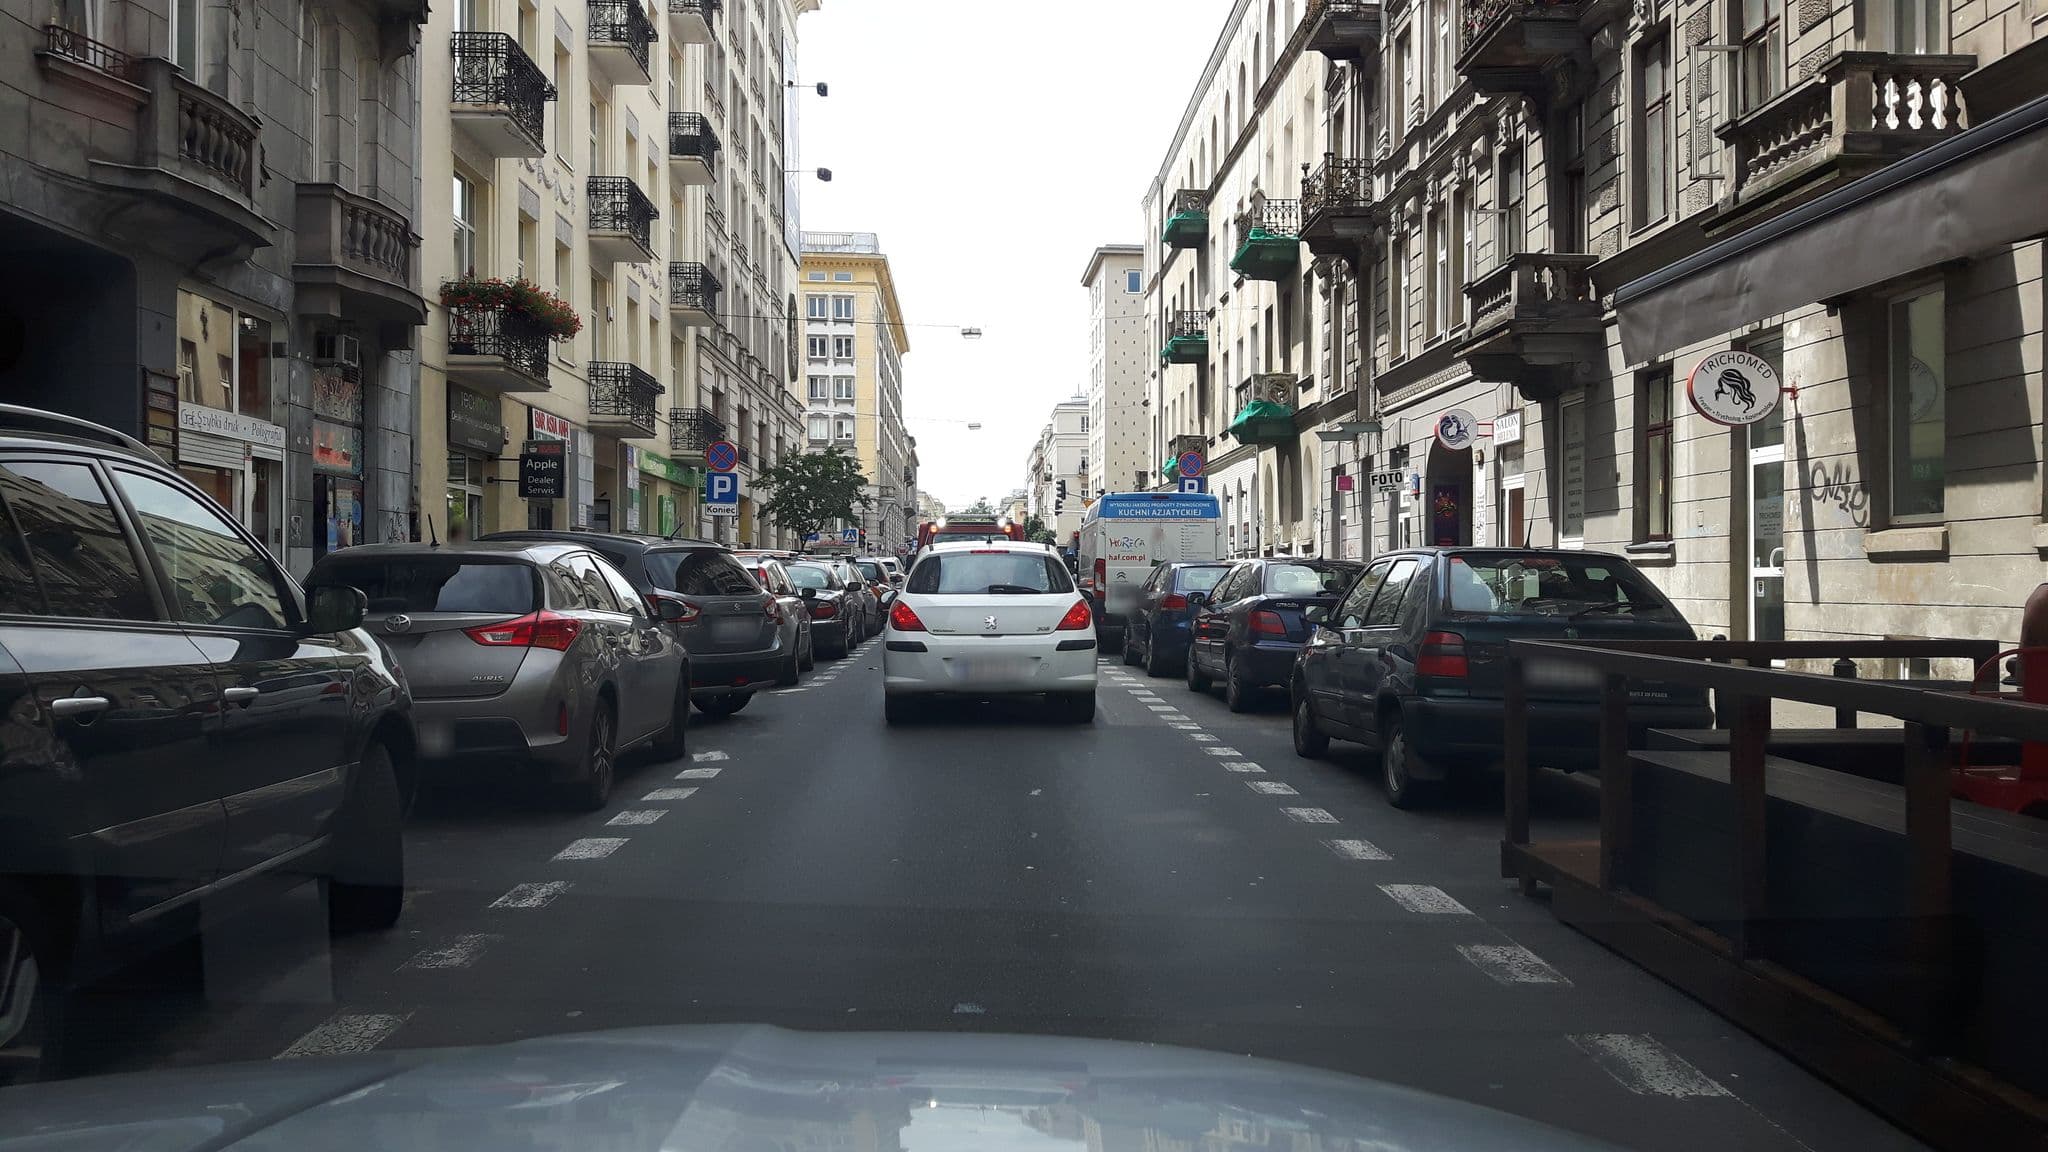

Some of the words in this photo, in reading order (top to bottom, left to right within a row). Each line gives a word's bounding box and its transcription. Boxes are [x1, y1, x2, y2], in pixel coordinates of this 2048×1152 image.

[1700, 353, 1772, 379] TRICHOMED
[534, 410, 546, 430] BAR
[1496, 415, 1519, 431] SALON
[526, 459, 558, 471] Apple
[527, 476, 555, 484] Dealer
[1371, 472, 1403, 486] FOTO
[527, 486, 555, 495] Serwis
[713, 475, 732, 500] P
[706, 504, 736, 514] Koniec
[1118, 508, 1150, 516] KUCHNI
[1151, 508, 1202, 516] AZJATYCKIEJ
